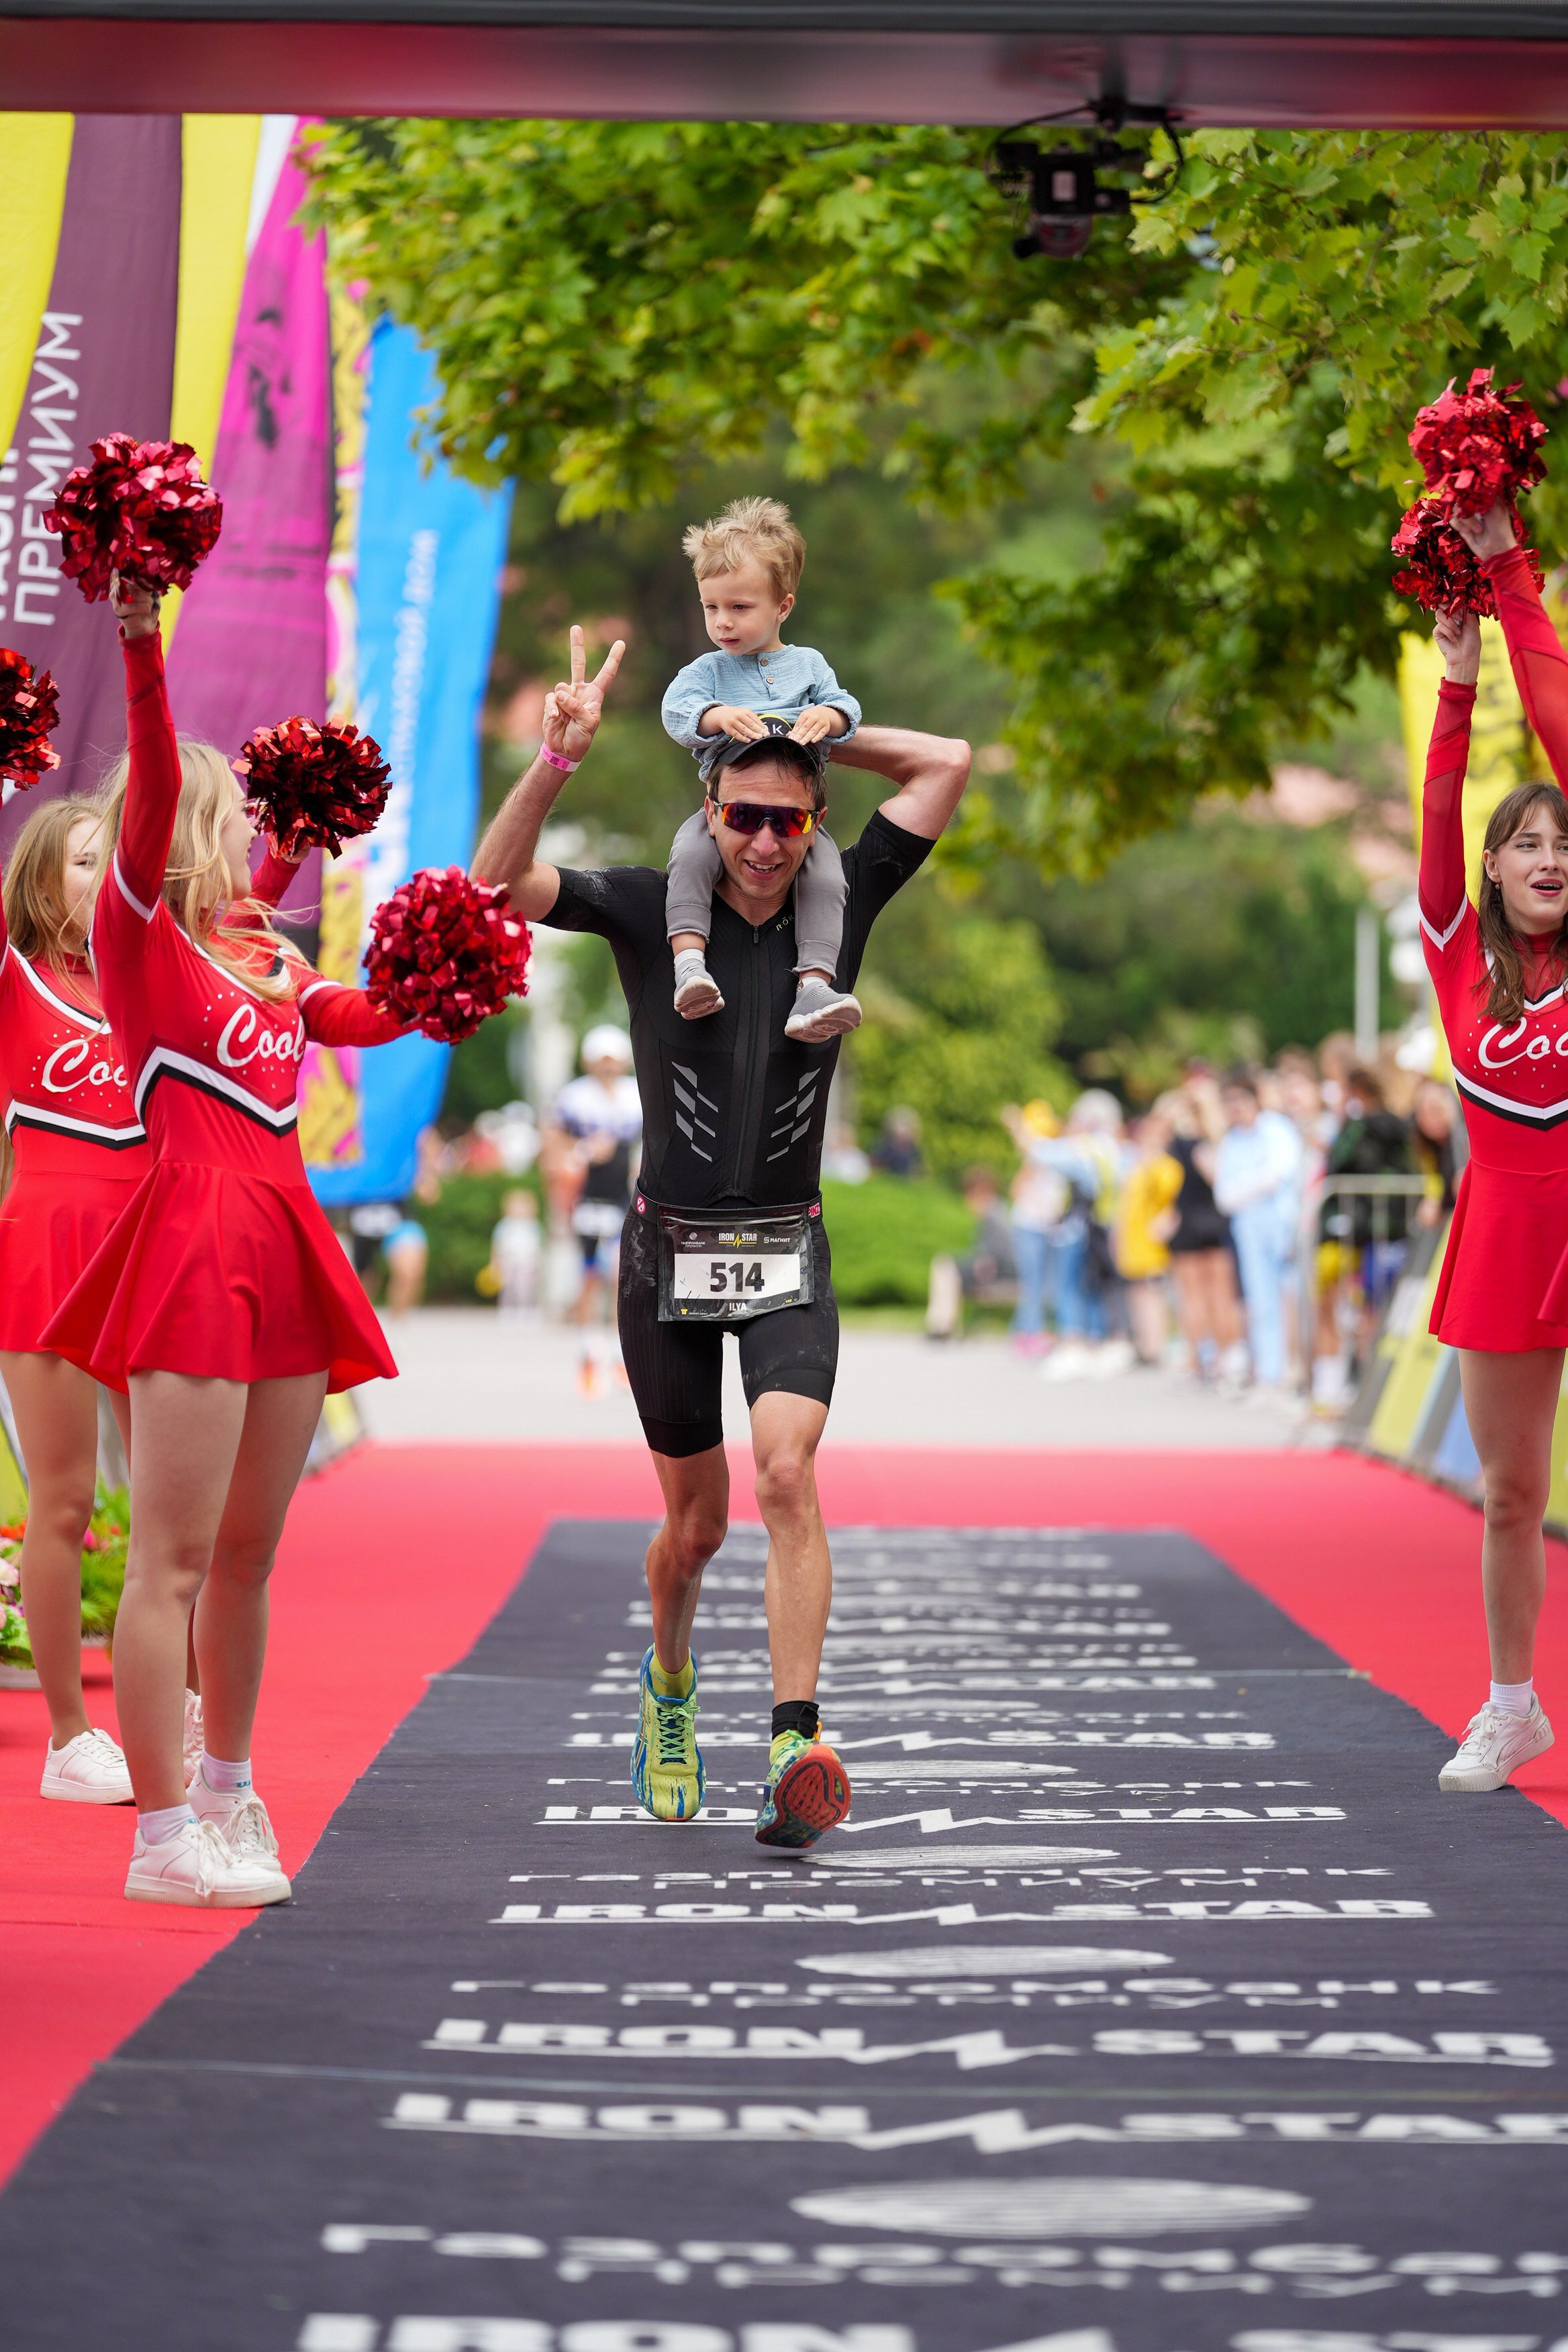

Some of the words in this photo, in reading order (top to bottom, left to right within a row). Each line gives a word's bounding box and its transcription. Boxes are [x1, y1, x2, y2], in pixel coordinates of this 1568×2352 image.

[13, 311, 83, 626] ПРЕМИУМ
[719, 1233, 735, 1241] IRON
[742, 1233, 757, 1241] STAR
[710, 1263, 765, 1292] 514
[729, 1303, 746, 1311] ILYA
[1018, 1806, 1346, 1820] STAR
[501, 1904, 858, 1919] IRON
[1052, 1900, 1434, 1916] STAR
[434, 2018, 865, 2048] IRON
[1093, 2028, 1553, 2058] STAR
[394, 2092, 871, 2132] IRON
[299, 2313, 914, 2352] IRON
